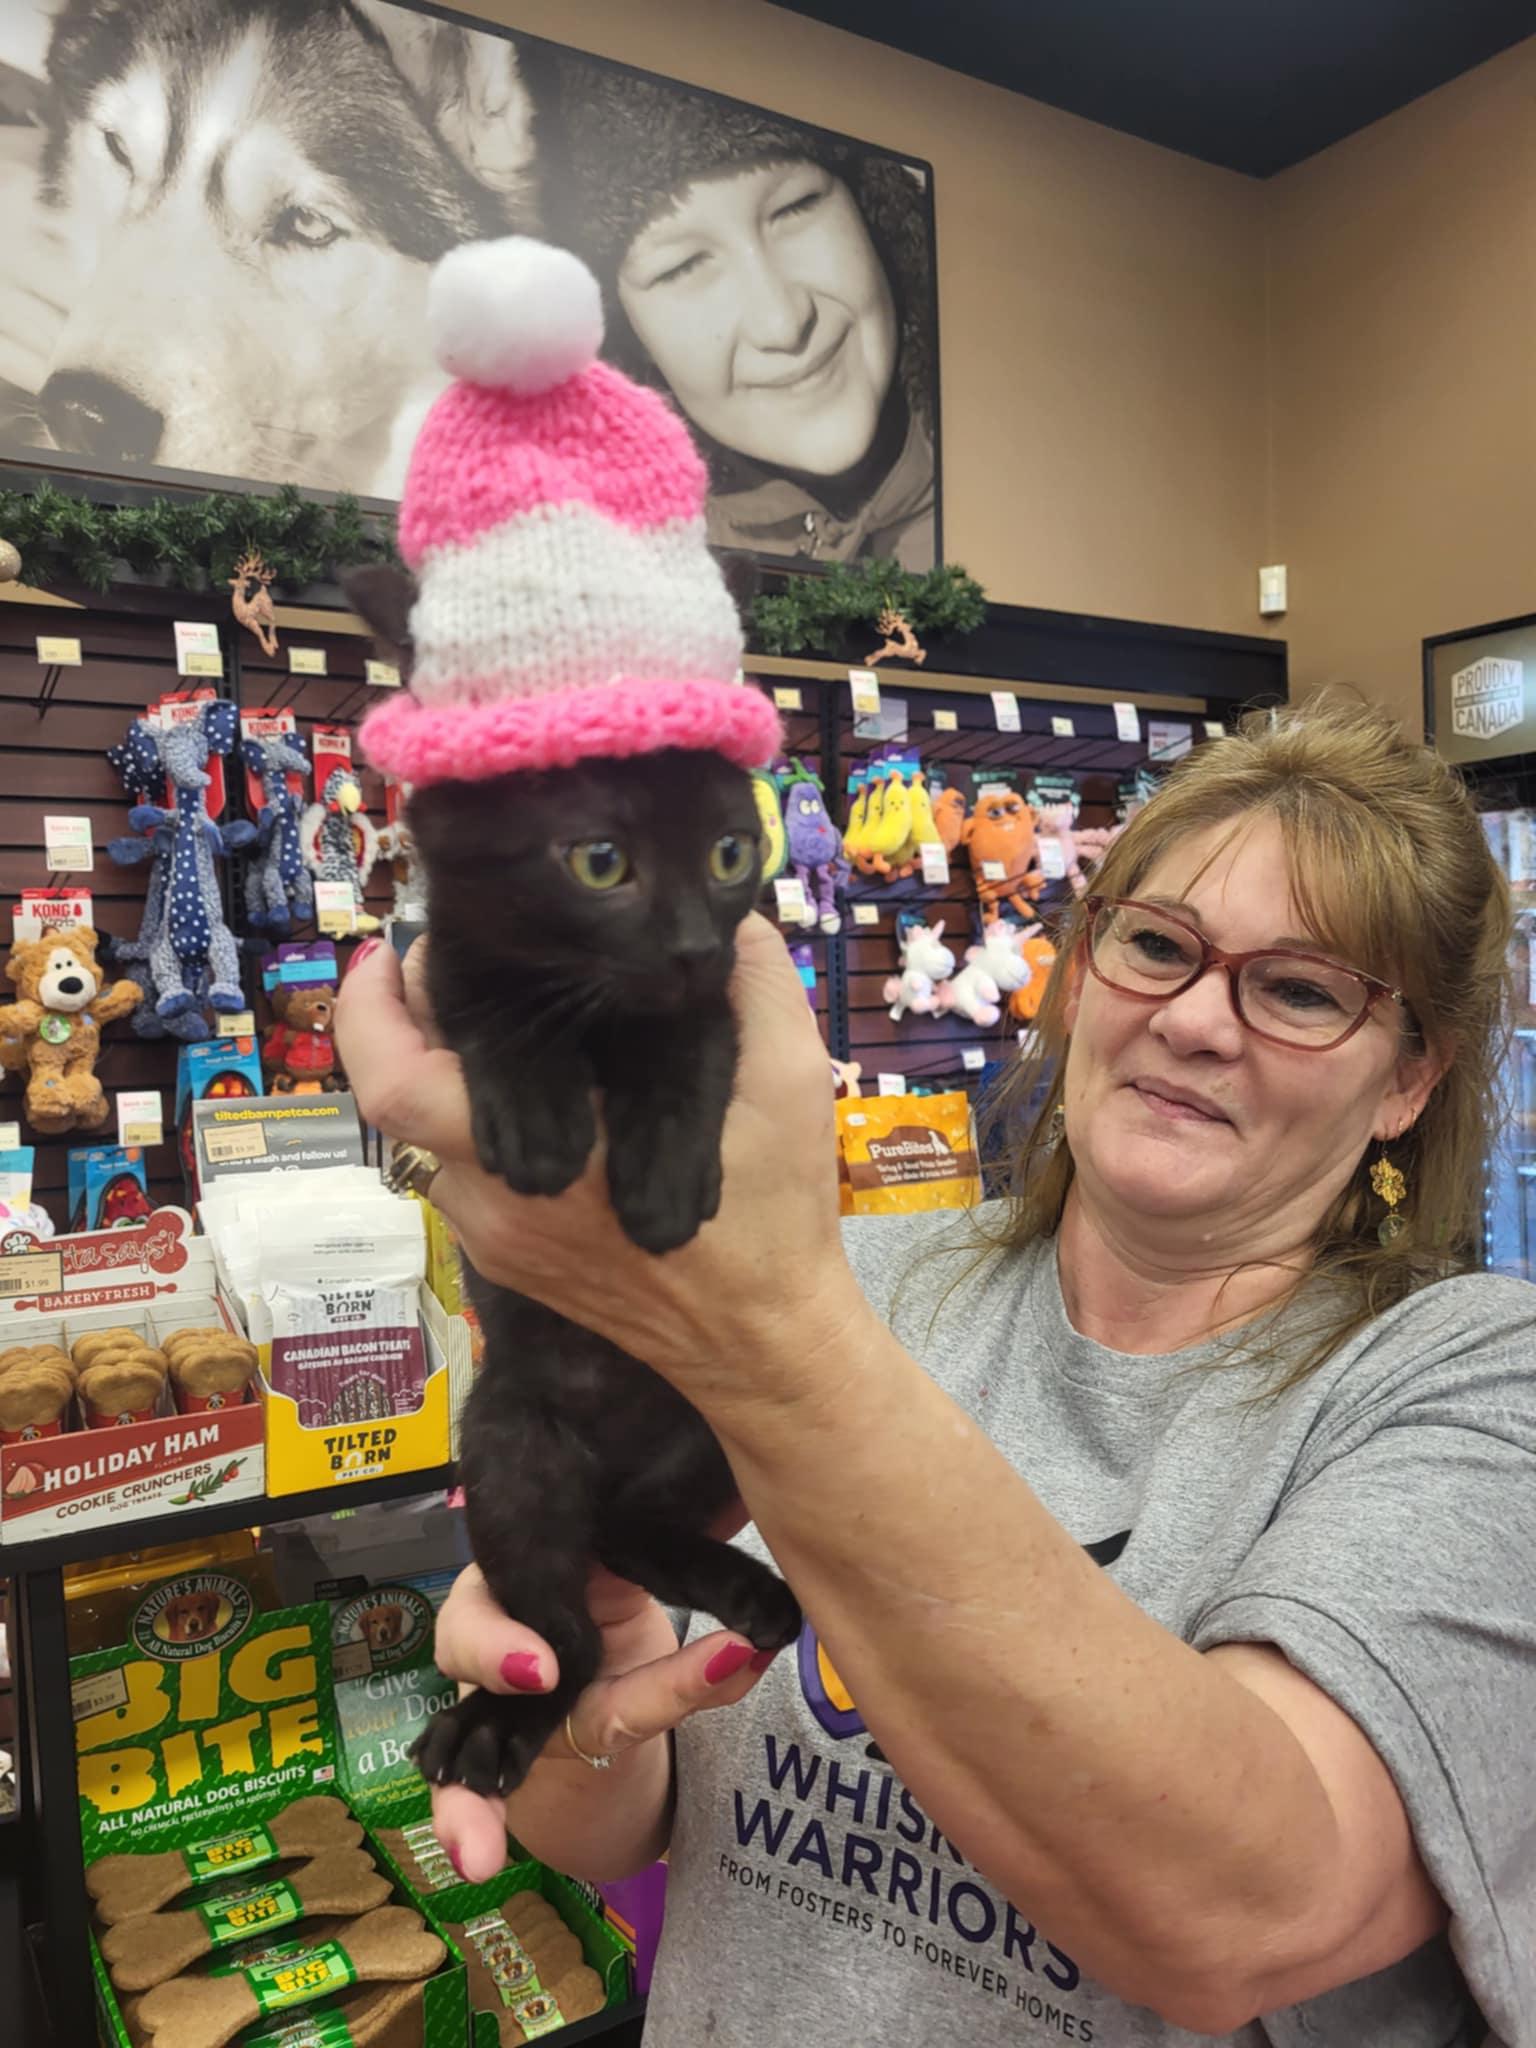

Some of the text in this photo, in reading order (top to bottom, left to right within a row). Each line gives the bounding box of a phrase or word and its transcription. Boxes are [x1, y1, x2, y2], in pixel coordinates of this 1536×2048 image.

[1457, 662, 1516, 695] PROUDLY
[1456, 701, 1518, 734] CANADA
[32, 903, 71, 918] KONG
[281, 1152, 301, 1163] and
[302, 1149, 331, 1160] follow
[333, 1148, 347, 1159] us!
[870, 1141, 934, 1159] PureBites
[25, 1278, 49, 1289] $1.99
[283, 1346, 341, 1363] CANADIAN
[342, 1340, 378, 1354] BACON
[324, 1428, 397, 1454] TILTED
[43, 1423, 221, 1493] HOLIDAY HAM
[56, 1463, 213, 1519] COOKIE CRUNCHERS
[110, 1492, 163, 1513] DOG TREATS
[137, 1576, 248, 1626] NATURE'S ANIMALS
[337, 1591, 426, 1635] NATURE'S ANIMALS
[148, 1638, 160, 1653] All
[161, 1643, 193, 1657] Natural
[194, 1640, 215, 1655] Dog
[75, 1624, 317, 1752] BIG
[77, 1699, 324, 1815] BITE
[358, 1752, 376, 1776] a
[98, 1764, 307, 1835] ALL NATURAL DOG BISCUITS
[734, 1789, 1080, 1991] WARRIORS
[719, 1854, 1094, 2043] FROM FOSTERS TO FOREVER HOMES
